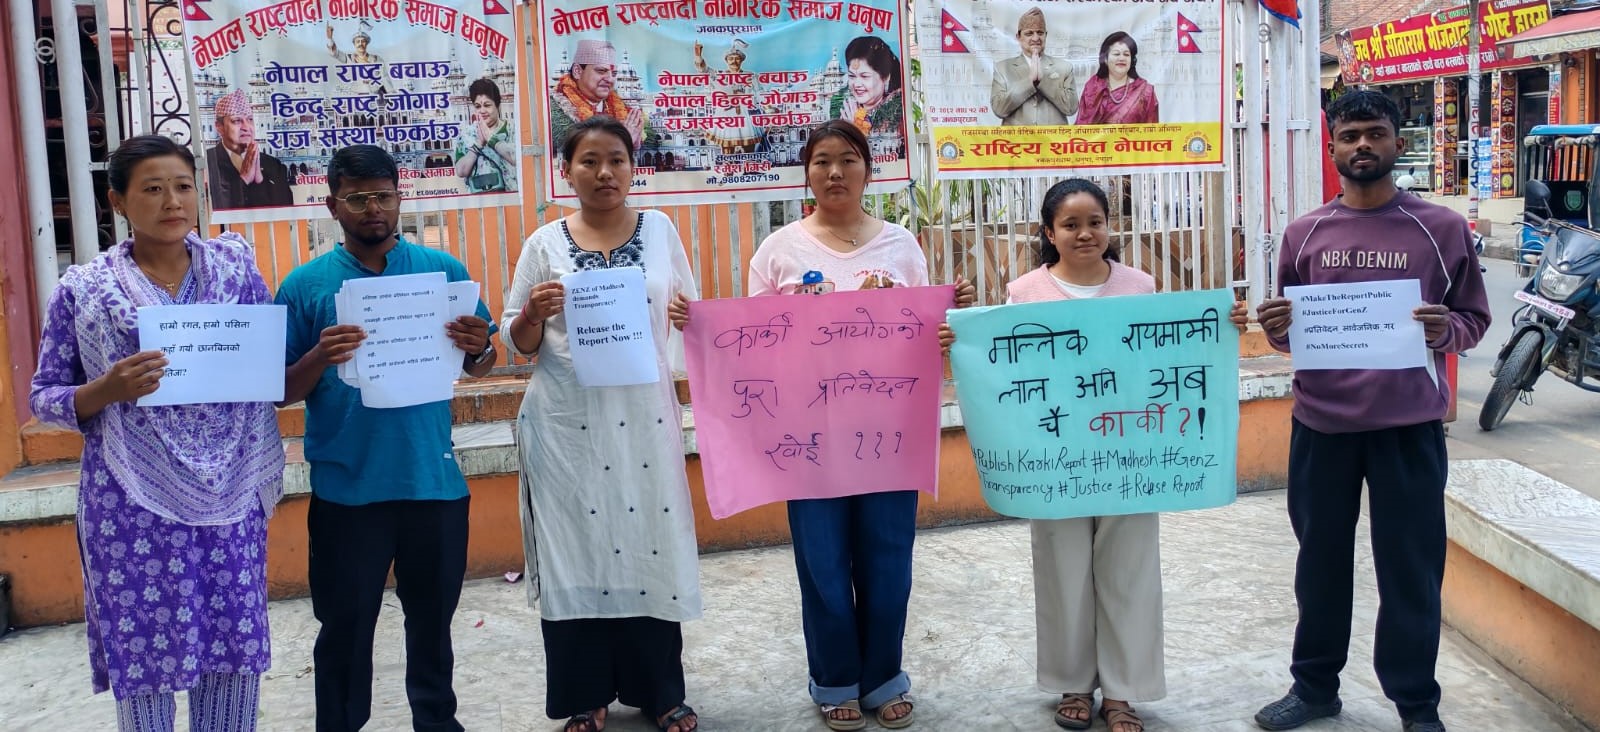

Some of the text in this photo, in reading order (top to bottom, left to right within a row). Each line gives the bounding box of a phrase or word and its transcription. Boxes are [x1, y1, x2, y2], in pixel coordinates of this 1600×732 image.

[550, 6, 611, 36] नेपाल
[786, 0, 844, 21] समाज
[847, 3, 895, 33] धनुषा
[192, 18, 246, 69] नेपाल
[405, 0, 459, 36] समाज
[461, 13, 510, 62] धनुषा
[1384, 22, 1427, 57] सीताराम
[1425, 14, 1471, 51] भोजनाल
[263, 61, 451, 86] नेपाल राष्ट्र बचाऊ
[658, 70, 808, 87] नेपाल राष्ट्र बचाऊ
[270, 88, 451, 121] हिन्दू राष्ट्र जोगाउ
[654, 90, 818, 108] नेपाल हिन्दू जोगाऊ
[663, 110, 812, 130] राजसंस्था फर्काऊ
[266, 119, 461, 151] राज संस्था फर्काऊ
[969, 138, 1042, 159] राष्ट्रिय
[1050, 138, 1107, 155] शक्ति
[1114, 137, 1173, 153] नेपाल
[425, 167, 456, 178] समाज
[1321, 250, 1408, 270] NBK DENIM
[1301, 291, 1393, 303] #MakeTheReportPublic
[1302, 306, 1369, 317] #JusticeForGenZ
[577, 322, 626, 335] Release the
[713, 311, 794, 357] कार्की
[578, 337, 609, 347] Report
[611, 333, 631, 343] Now
[1306, 342, 1370, 351] #NoMoreSecrets
[807, 369, 920, 409] प्रतिवेदन
[998, 377, 1050, 404] लाल
[1147, 365, 1214, 401] अब
[1091, 447, 1159, 475] #Madhesh
